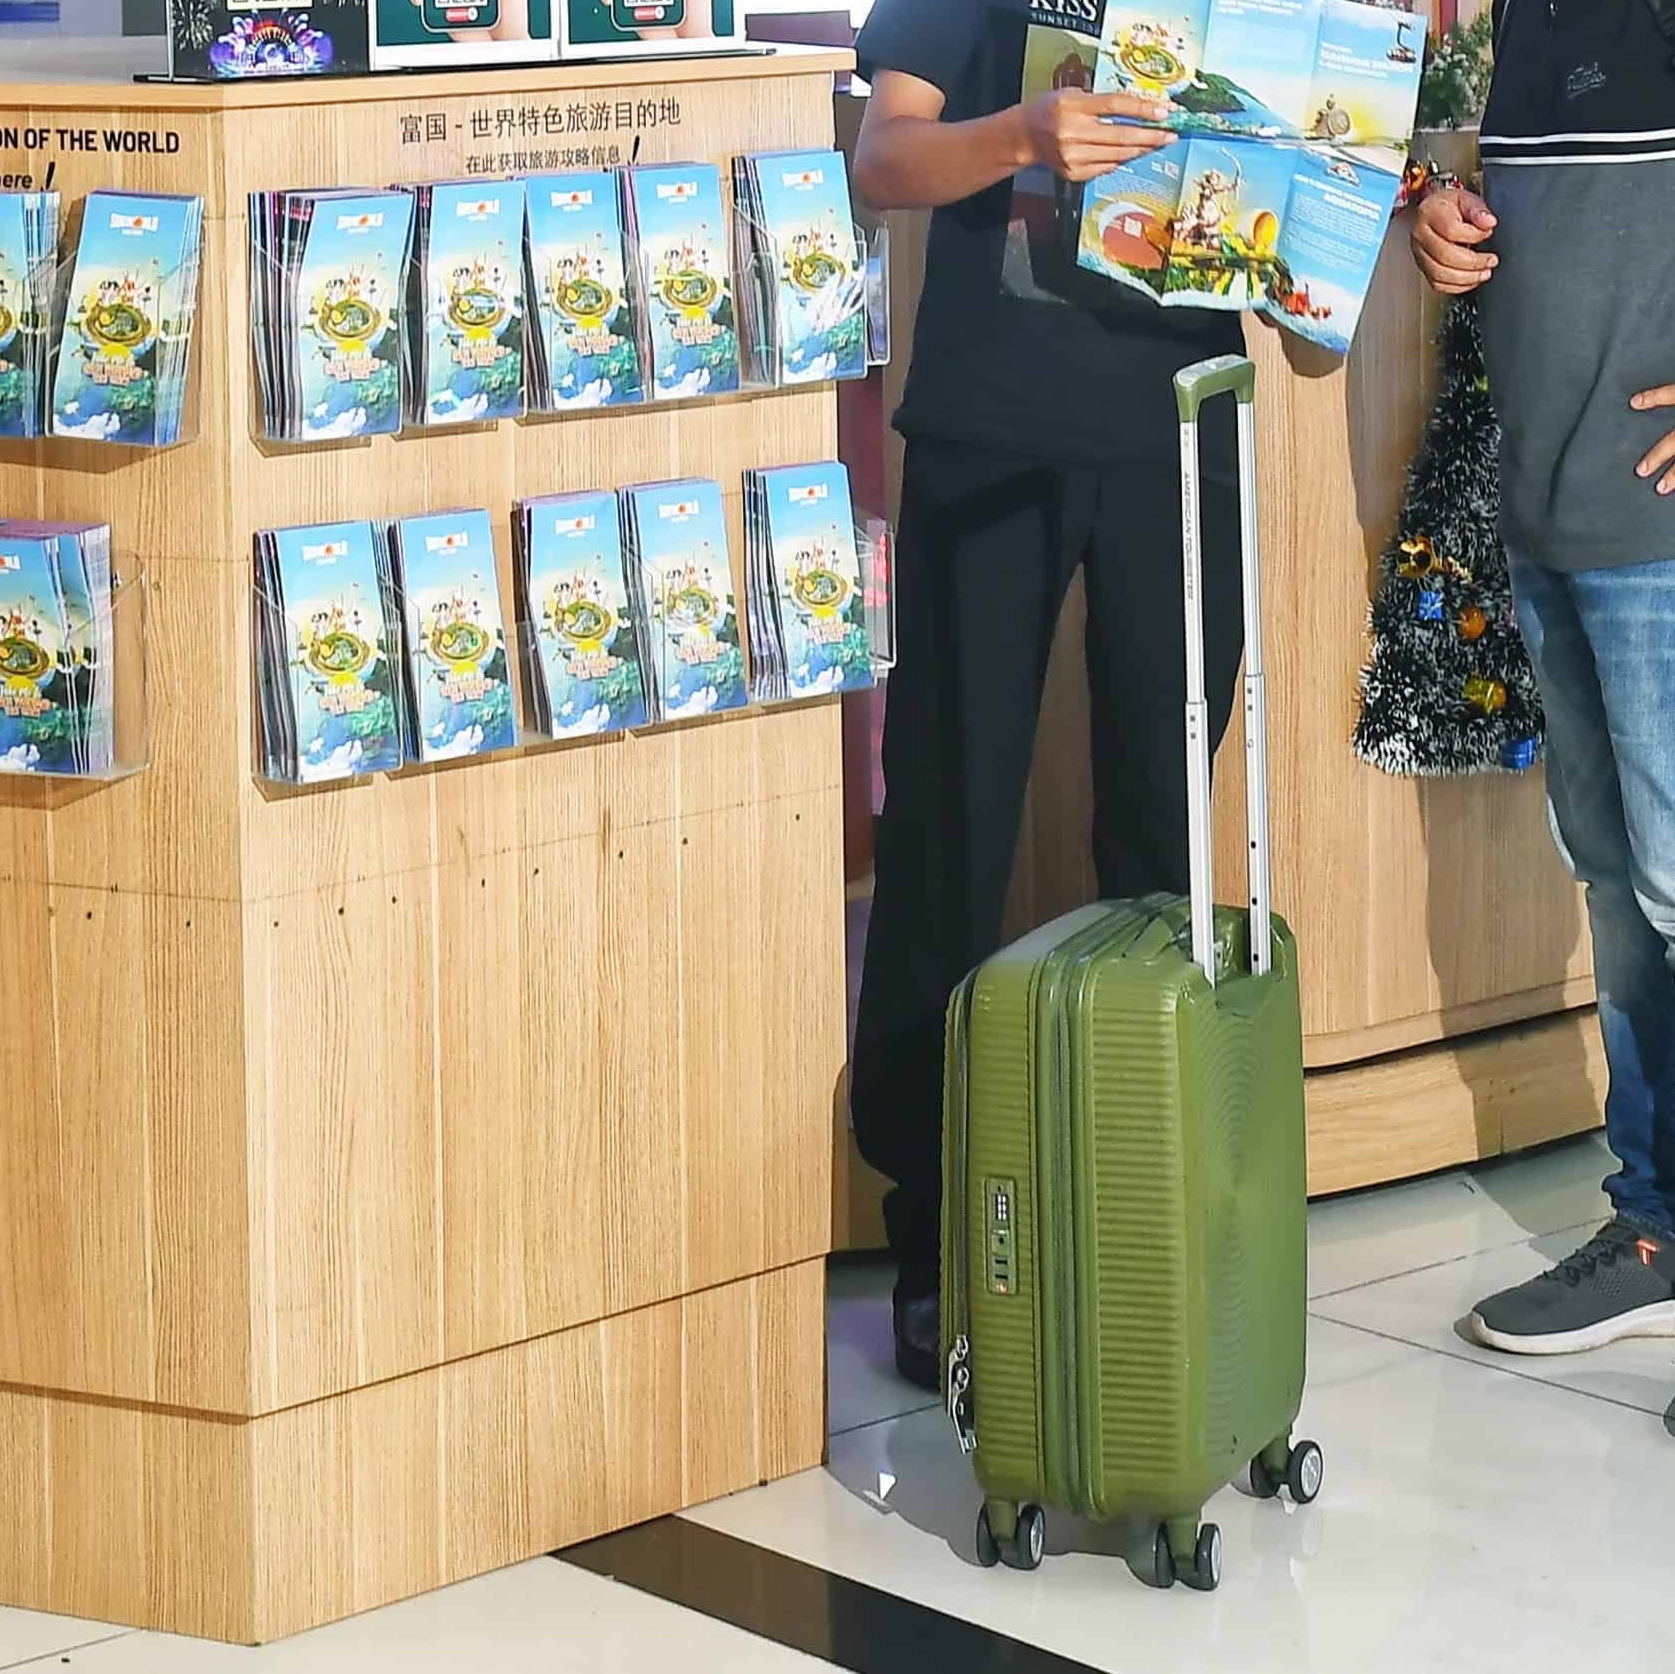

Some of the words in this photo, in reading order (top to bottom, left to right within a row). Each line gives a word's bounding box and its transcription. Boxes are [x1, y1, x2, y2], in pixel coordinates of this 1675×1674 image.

[399, 113, 448, 145] 富国
[469, 95, 683, 141] 世界特色旅游目的地
[25, 128, 51, 149] OF
[56, 129, 98, 151] THE
[103, 130, 180, 154] WORLD
[465, 144, 623, 174] 在此获取旅游攻略信息
